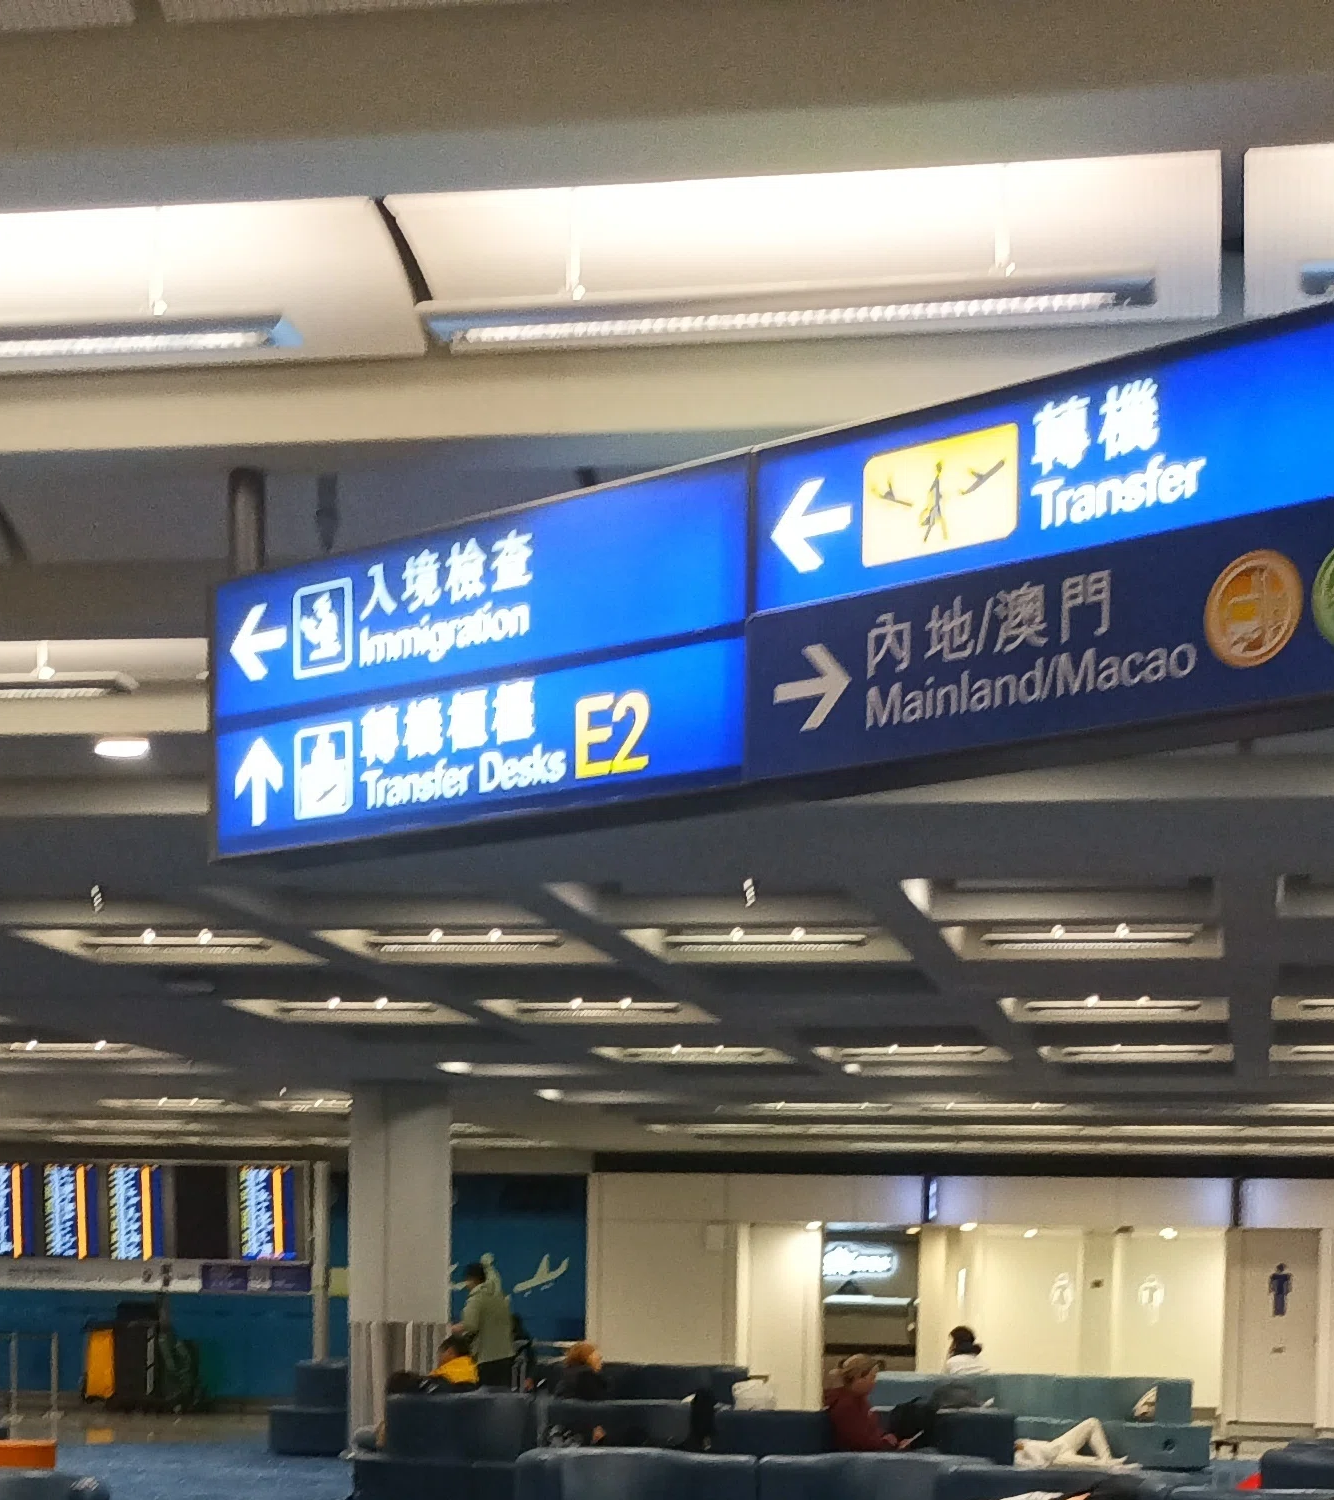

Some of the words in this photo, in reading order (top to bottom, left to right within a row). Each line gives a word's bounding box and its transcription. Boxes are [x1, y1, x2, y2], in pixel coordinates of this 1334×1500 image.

[1031, 377, 1161, 477] 轉機
[1030, 453, 1208, 531] Transfer
[359, 528, 534, 623] 入境檢查
[359, 600, 531, 669] Immigration
[865, 642, 1199, 732] Mainland/Macao
[359, 757, 474, 811] Transfer
[478, 743, 567, 795] Desks
[574, 690, 651, 780] E2
